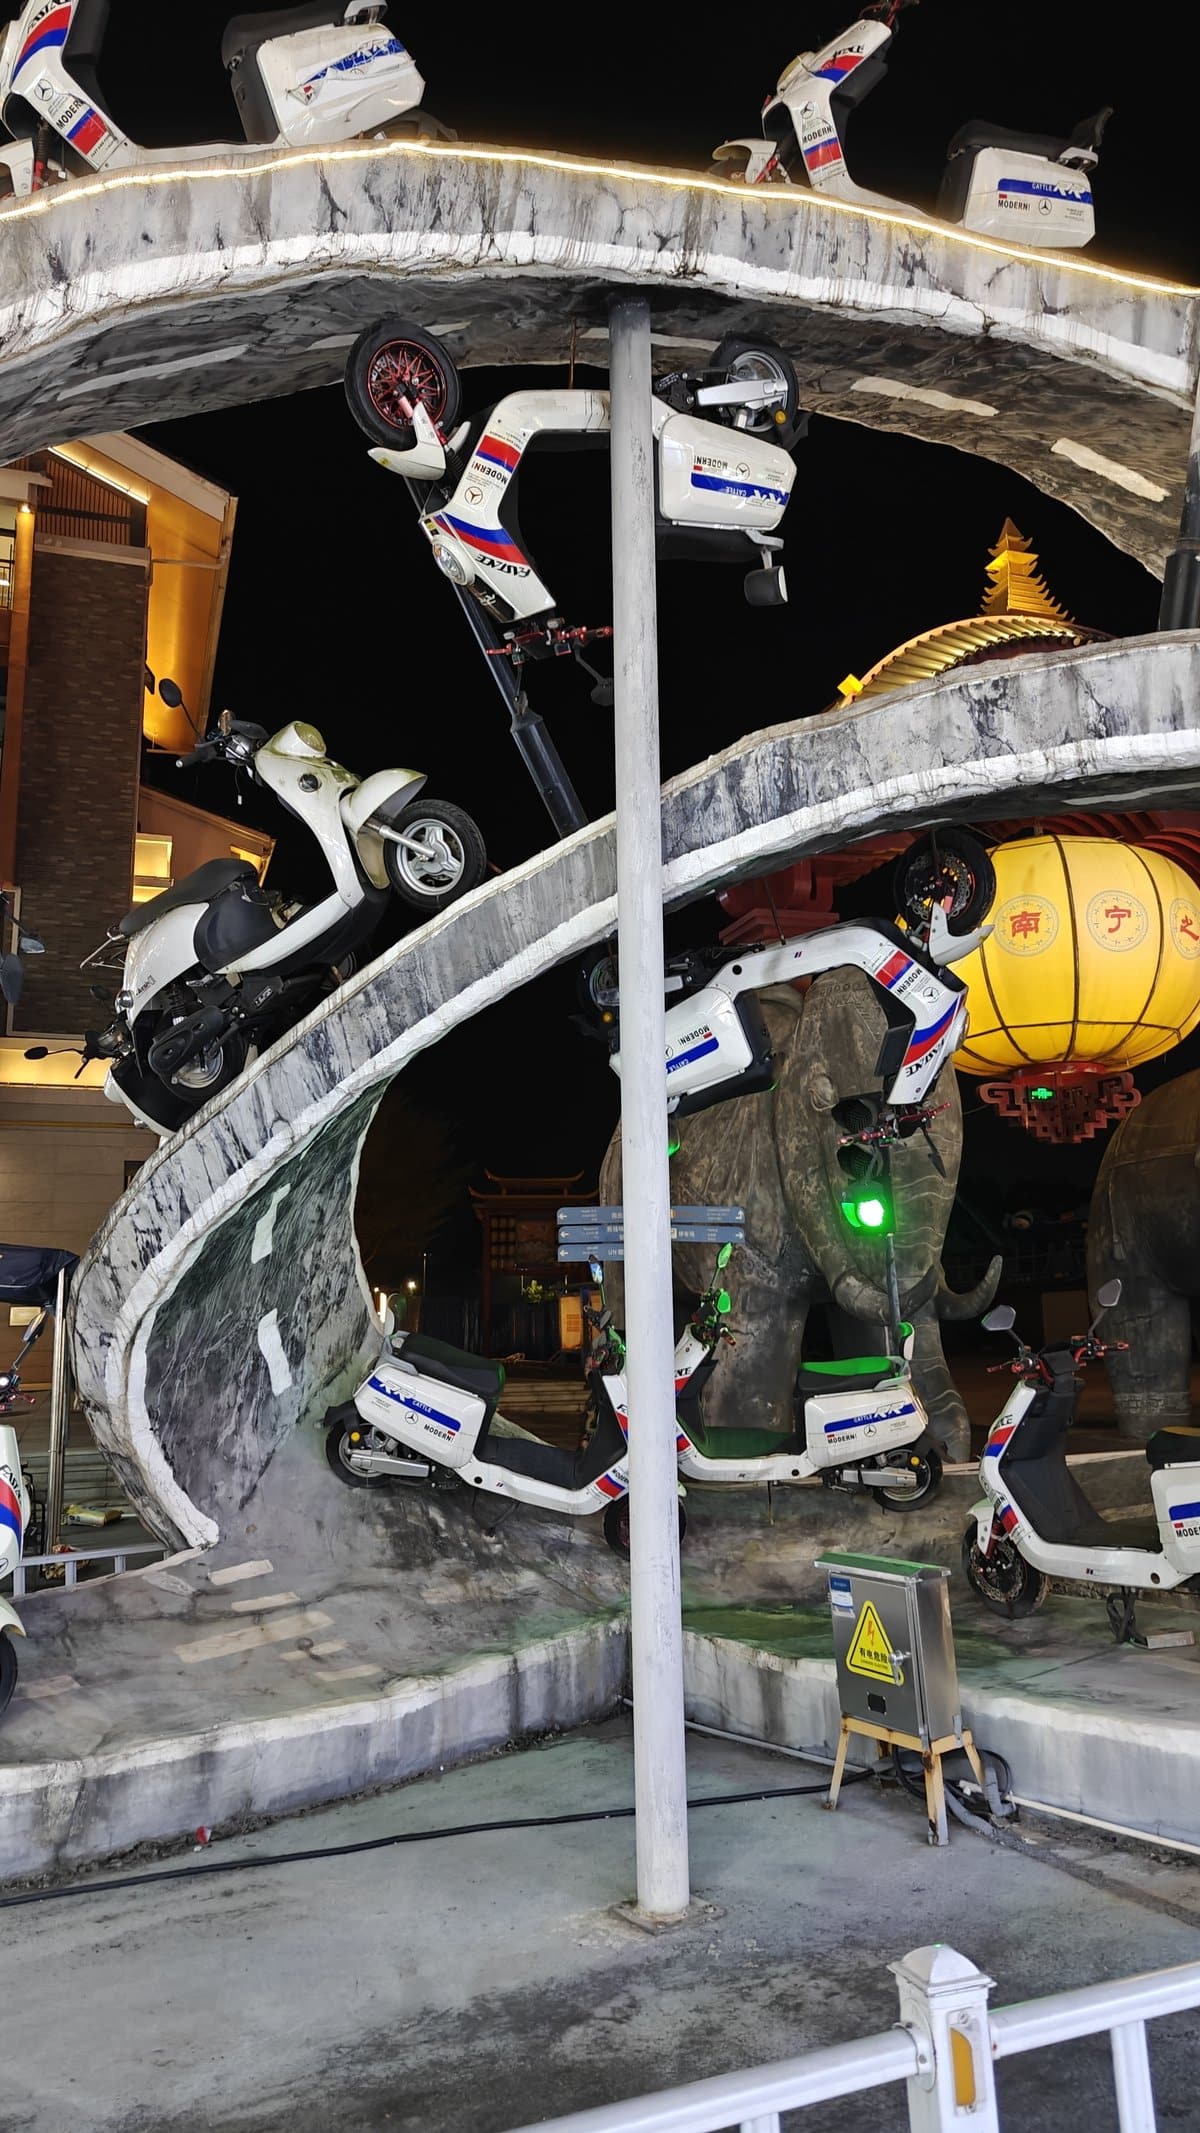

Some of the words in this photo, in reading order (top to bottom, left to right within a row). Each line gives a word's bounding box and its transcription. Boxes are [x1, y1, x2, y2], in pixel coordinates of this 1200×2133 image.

[1031, 182, 1053, 192] CATTLE
[726, 486, 747, 497] CATTLE
[412, 1400, 432, 1414] CATTLE
[1176, 1526, 1200, 1538] MODE
